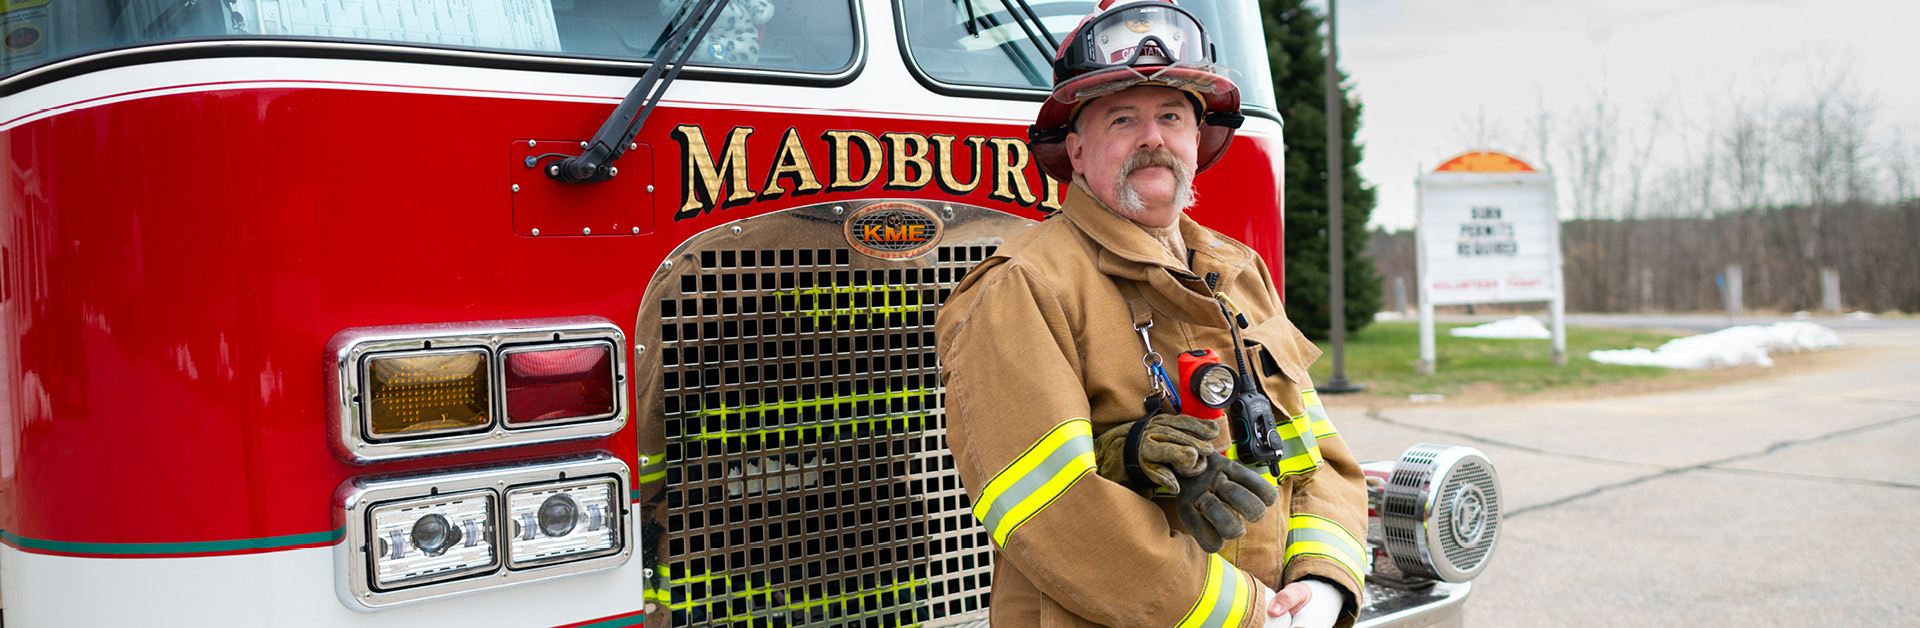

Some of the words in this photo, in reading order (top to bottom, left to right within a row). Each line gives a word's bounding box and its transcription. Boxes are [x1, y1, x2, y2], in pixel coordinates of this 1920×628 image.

[1121, 46, 1167, 60] CATAIN
[866, 203, 894, 213] WORLD
[1471, 206, 1502, 220] BURN
[864, 224, 926, 243] KME
[1460, 224, 1515, 238] PERMITS
[1457, 242, 1518, 256] REQUIRED
